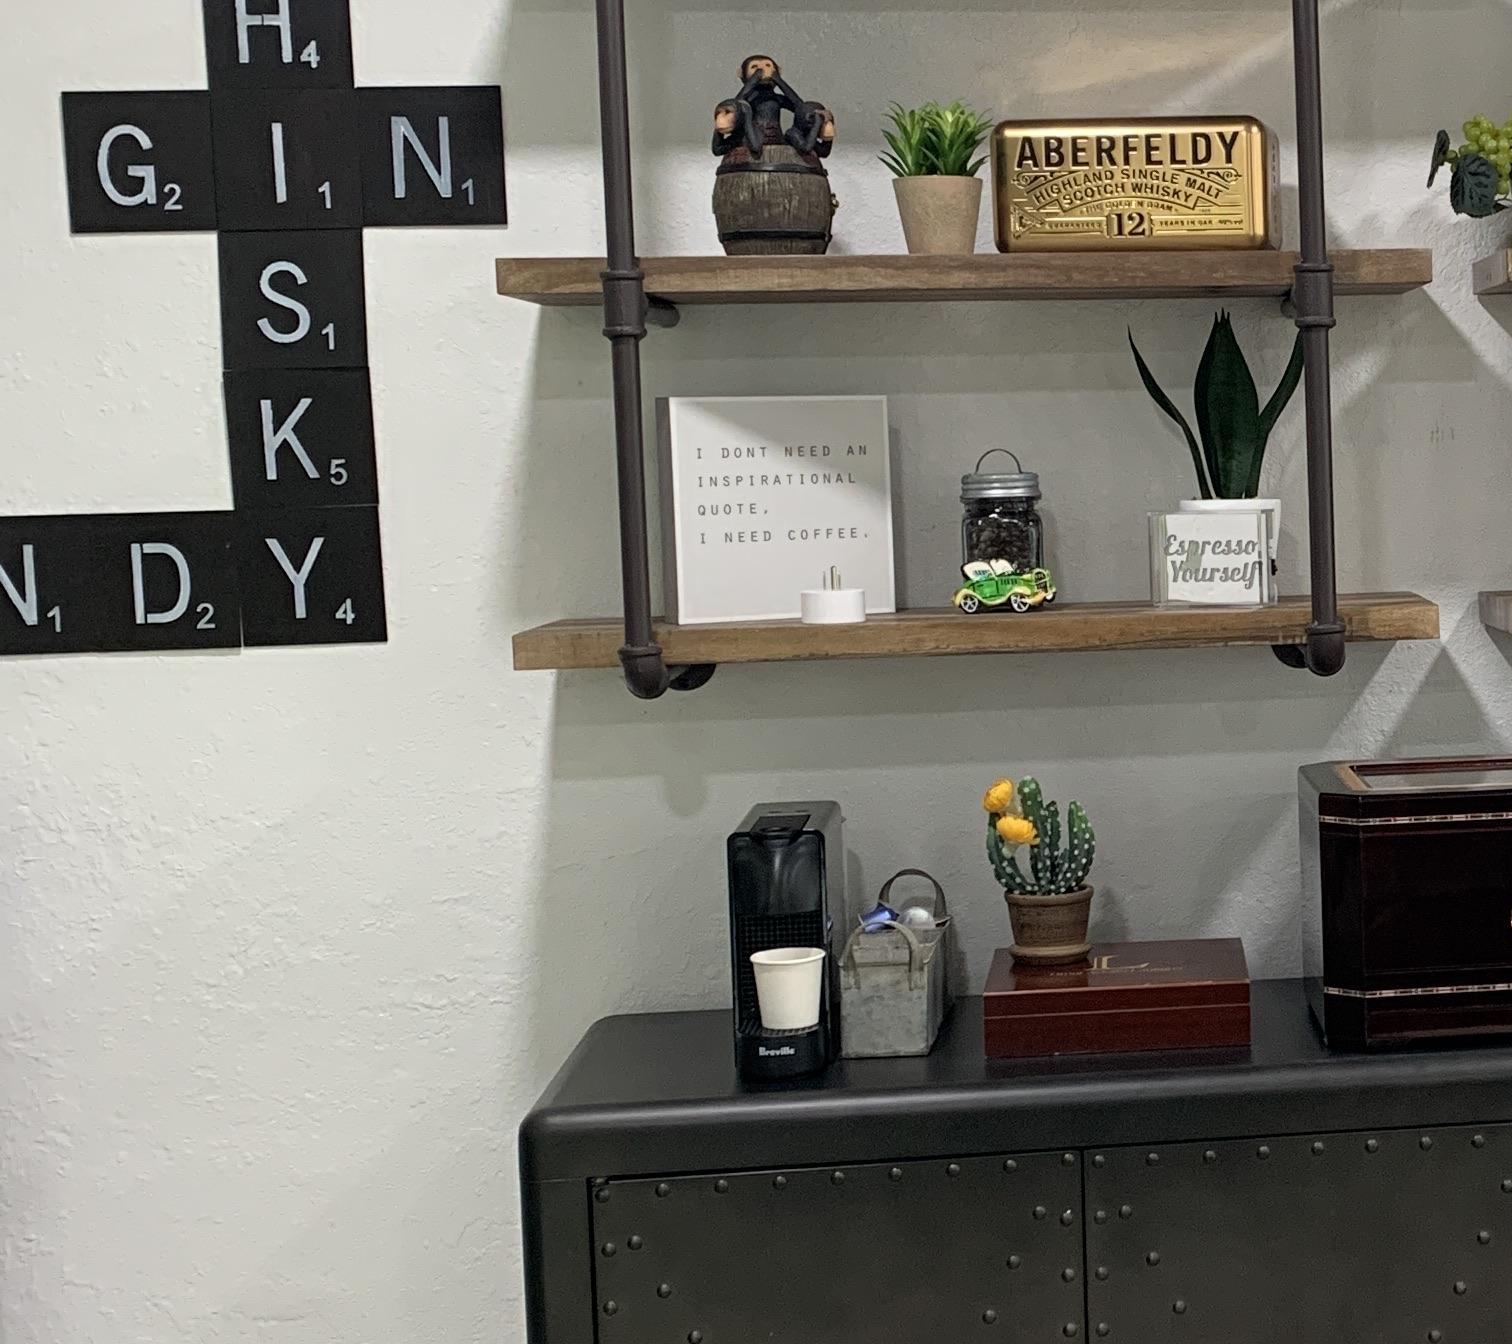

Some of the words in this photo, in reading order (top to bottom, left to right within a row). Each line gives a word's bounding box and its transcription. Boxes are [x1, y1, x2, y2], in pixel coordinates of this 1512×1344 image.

[97, 116, 453, 206] GIN
[1014, 132, 1240, 170] ABERFELDY
[1034, 170, 1115, 205] HIGHLAND
[1121, 168, 1180, 184] SINGLE
[1185, 177, 1223, 200] MALT
[1063, 183, 1126, 207] SCOTCH
[1131, 182, 1193, 203] WHISKY
[1147, 200, 1173, 212] DRAM
[1110, 212, 1145, 236] 12
[696, 447, 703, 460] I
[721, 447, 768, 460] DONT
[784, 445, 832, 458] NEED
[846, 444, 868, 456] AN
[697, 472, 857, 488] INSPIRATIONAL
[700, 532, 706, 545] I
[724, 530, 773, 543] NEED
[787, 527, 869, 541] COFFEE.
[1164, 534, 1258, 558] Espresso
[1170, 560, 1263, 590] Yourself
